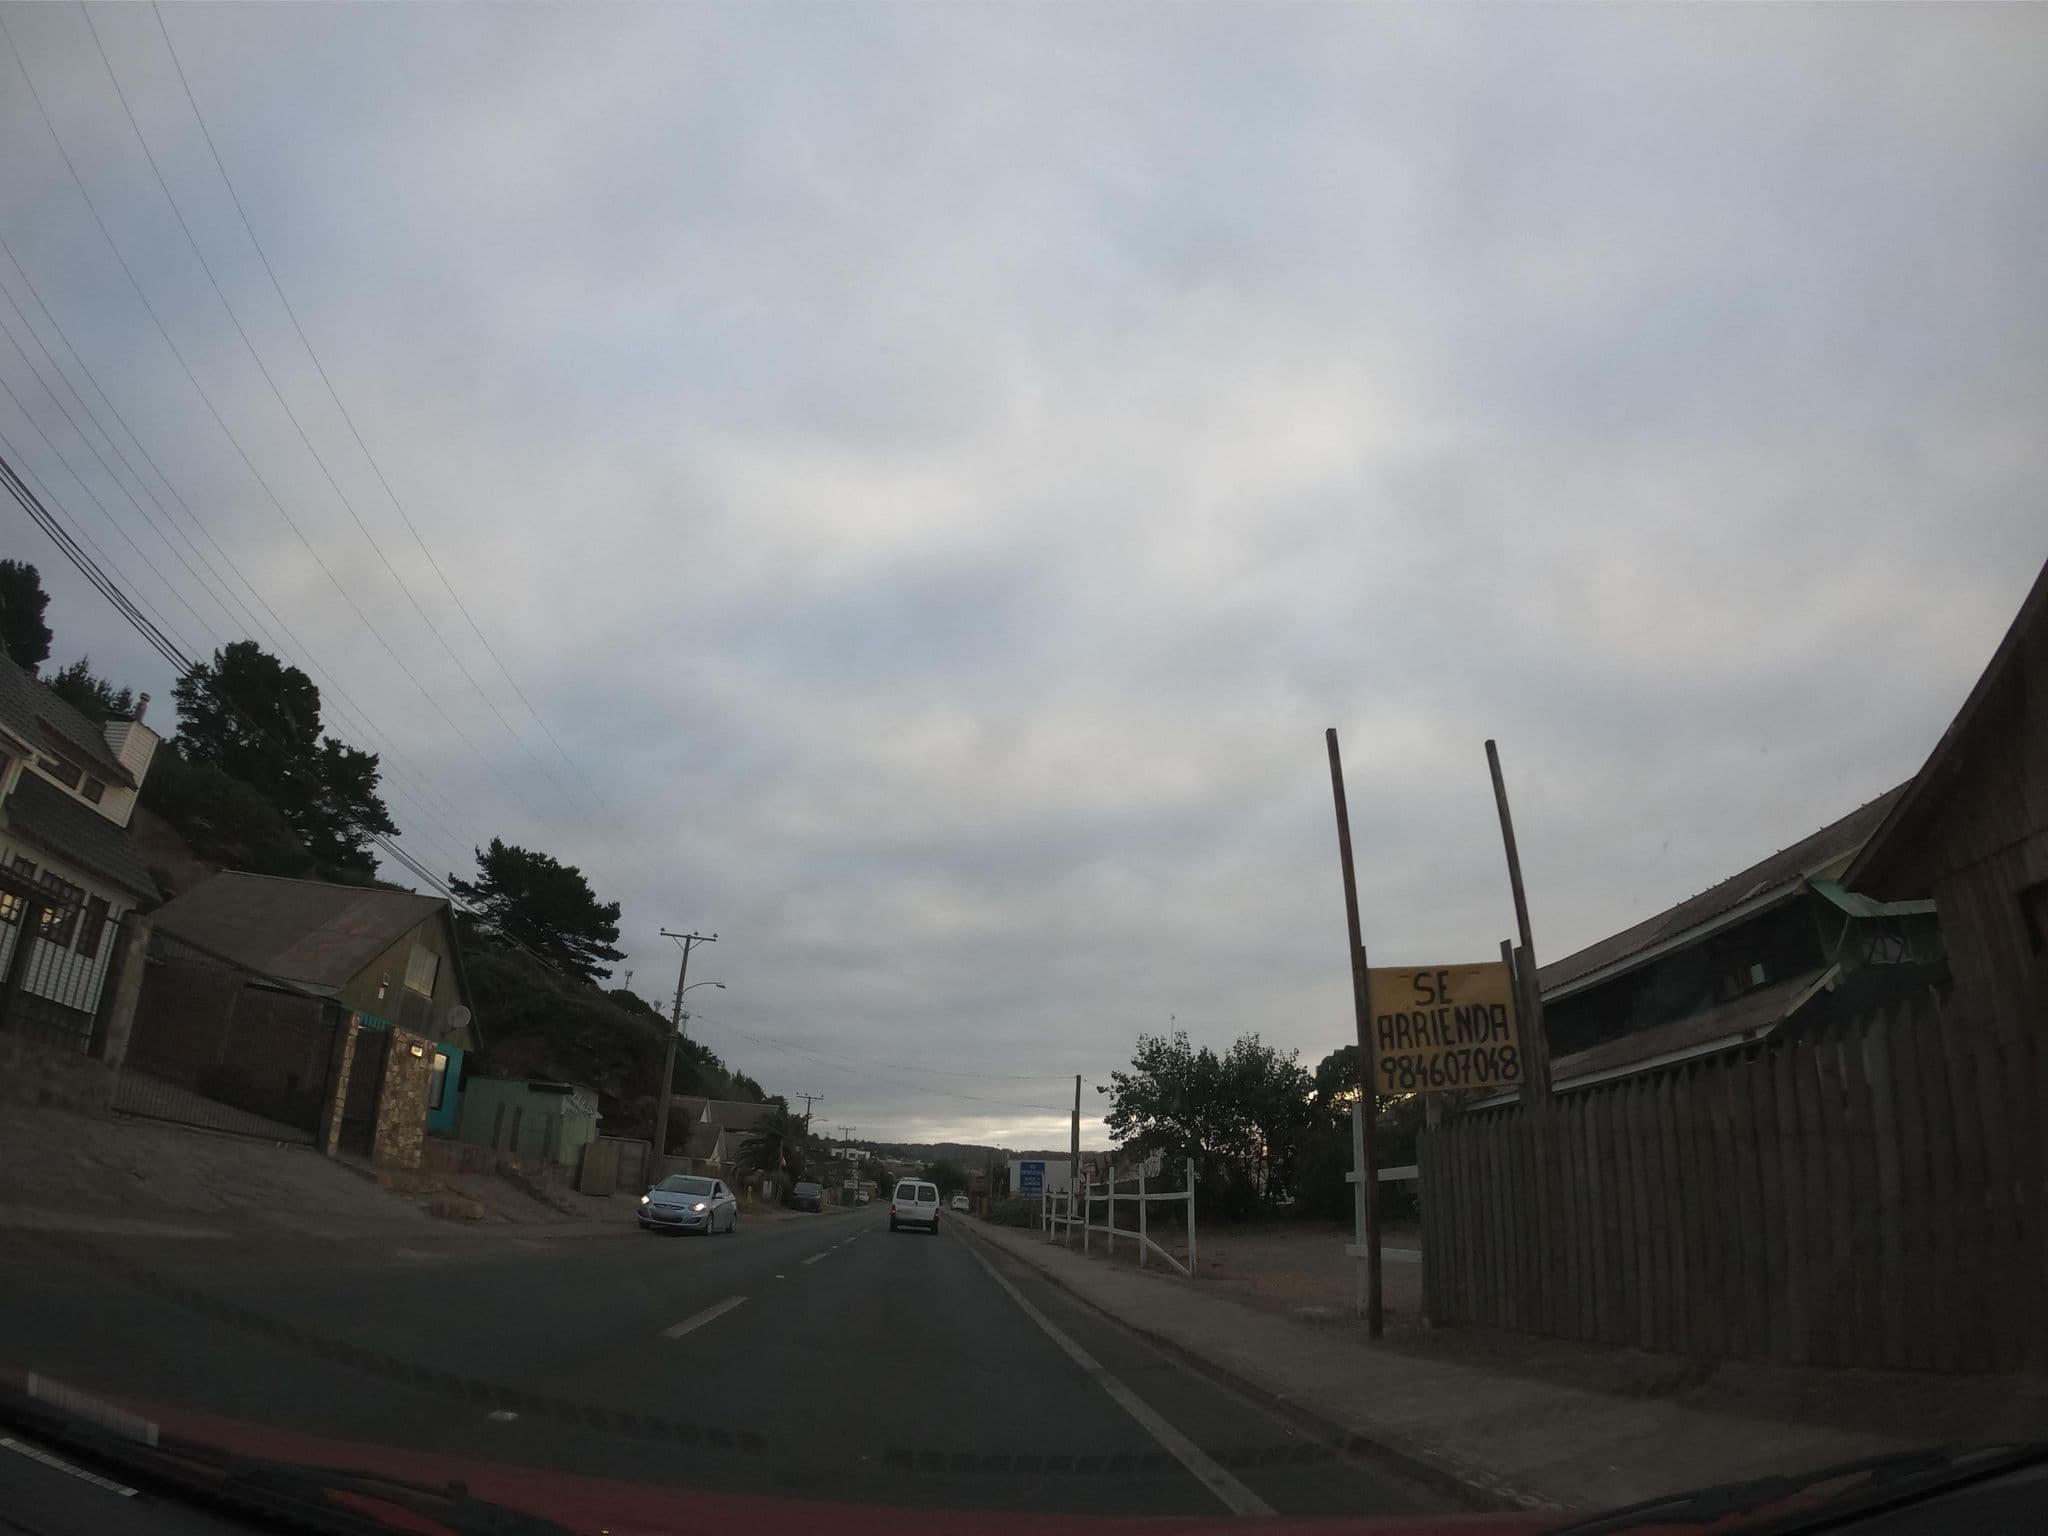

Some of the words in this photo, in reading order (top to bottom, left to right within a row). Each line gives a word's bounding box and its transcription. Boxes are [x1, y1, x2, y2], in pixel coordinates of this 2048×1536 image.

[1413, 970, 1453, 1006] SE
[1377, 1003, 1510, 1051] ARRIENDA
[1381, 1045, 1520, 1089] 984607048
